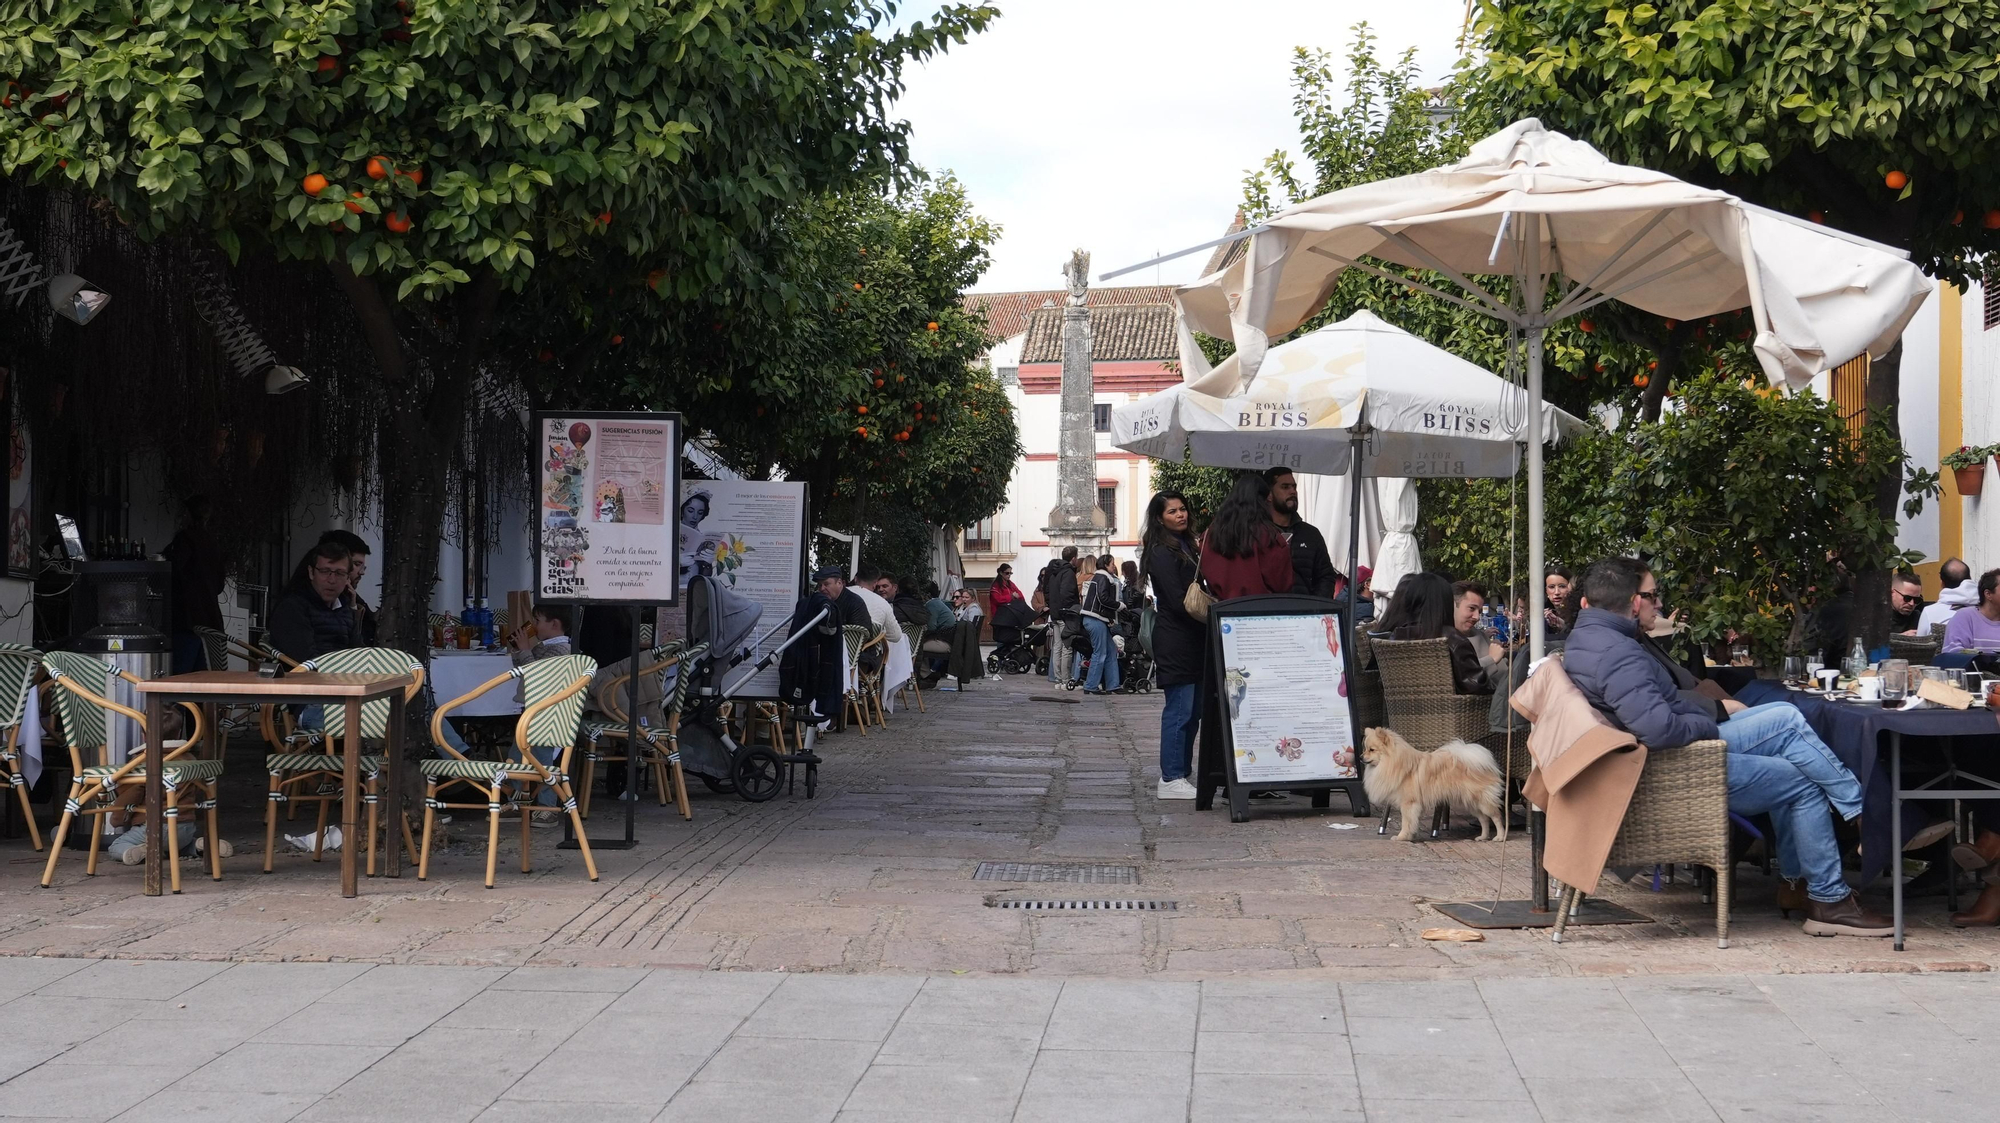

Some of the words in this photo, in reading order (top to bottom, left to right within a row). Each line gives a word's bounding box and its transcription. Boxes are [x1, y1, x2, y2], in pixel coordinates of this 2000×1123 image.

[1255, 403, 1293, 411] ROYAL
[1440, 404, 1476, 416] ROYAL
[1238, 412, 1308, 427] BLISS
[1423, 412, 1491, 434] BLISS
[602, 427, 640, 435] SUGERENCIAS
[628, 547, 636, 555] la
[638, 547, 657, 555] buena
[548, 559, 566, 567] su
[596, 558, 620, 566] comida
[548, 568, 566, 580] ge
[630, 570, 653, 582] mejores
[543, 582, 573, 594] cias
